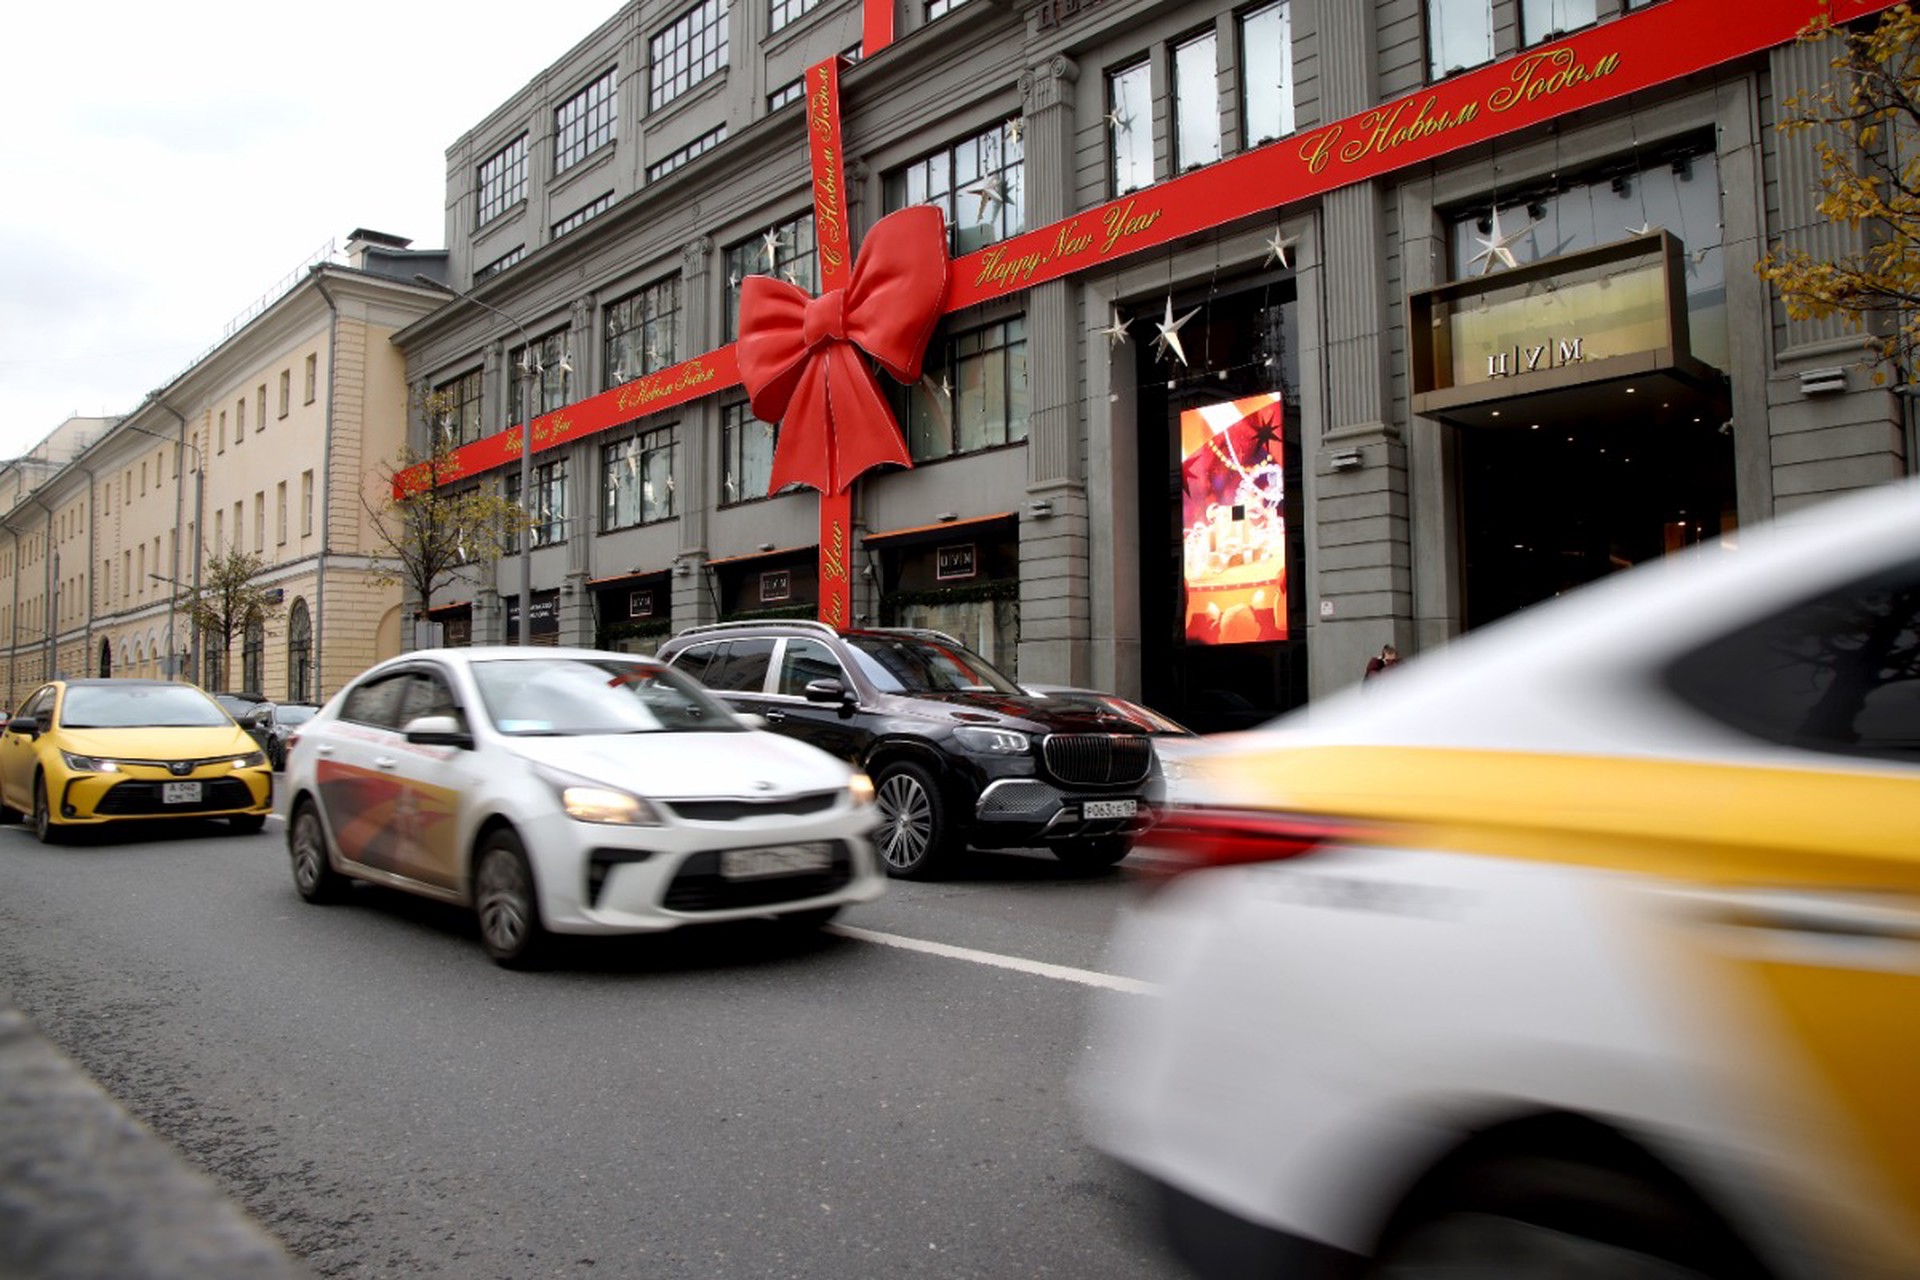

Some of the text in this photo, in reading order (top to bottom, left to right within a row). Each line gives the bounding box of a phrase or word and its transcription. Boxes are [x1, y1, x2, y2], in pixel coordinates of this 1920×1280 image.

[811, 66, 832, 143] Годом
[1299, 48, 1621, 175] С Новым Годом
[817, 147, 840, 243] Новым
[975, 199, 1163, 289] Happy New Year
[628, 377, 673, 408] Новым
[674, 361, 715, 391] Годом
[823, 519, 847, 583] Year
